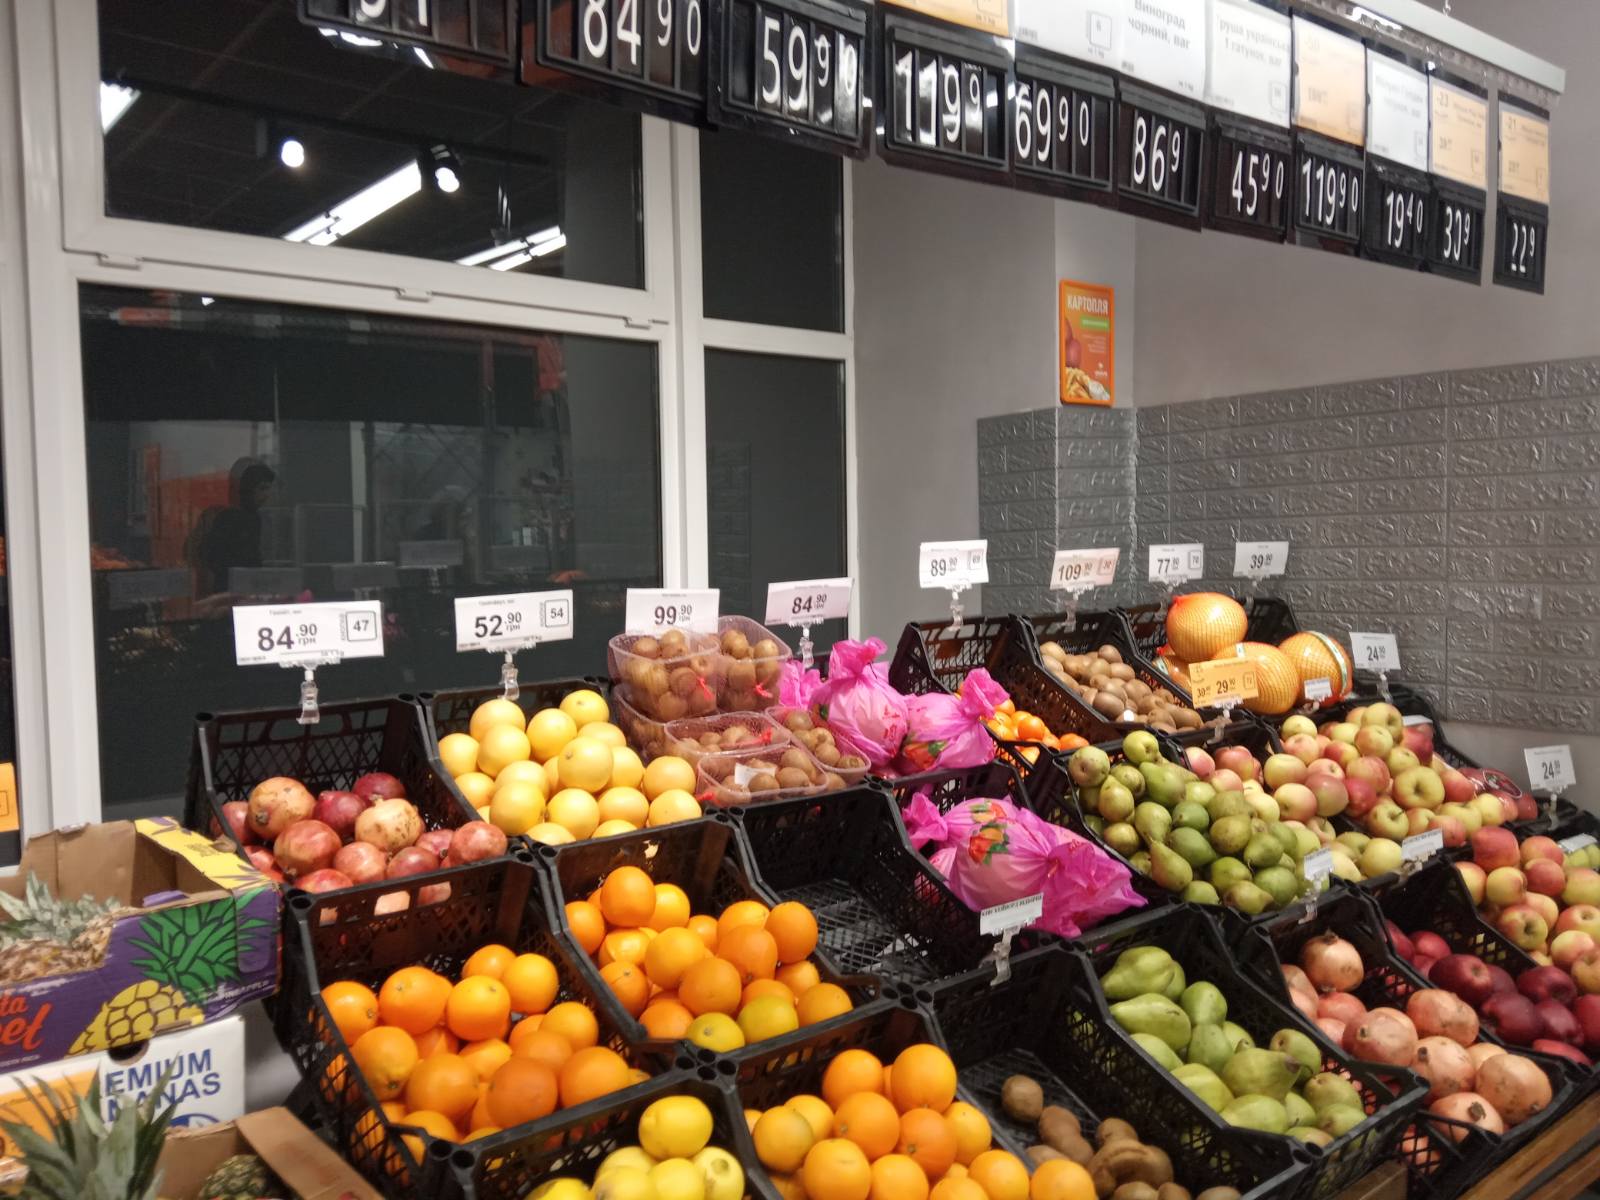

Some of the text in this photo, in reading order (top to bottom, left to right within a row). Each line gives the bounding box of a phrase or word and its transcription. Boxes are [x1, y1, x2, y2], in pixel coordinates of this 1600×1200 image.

[1067, 294, 1109, 316] КАРТОПЛЯ
[550, 608, 564, 619] 54
[353, 619, 369, 632] 47
